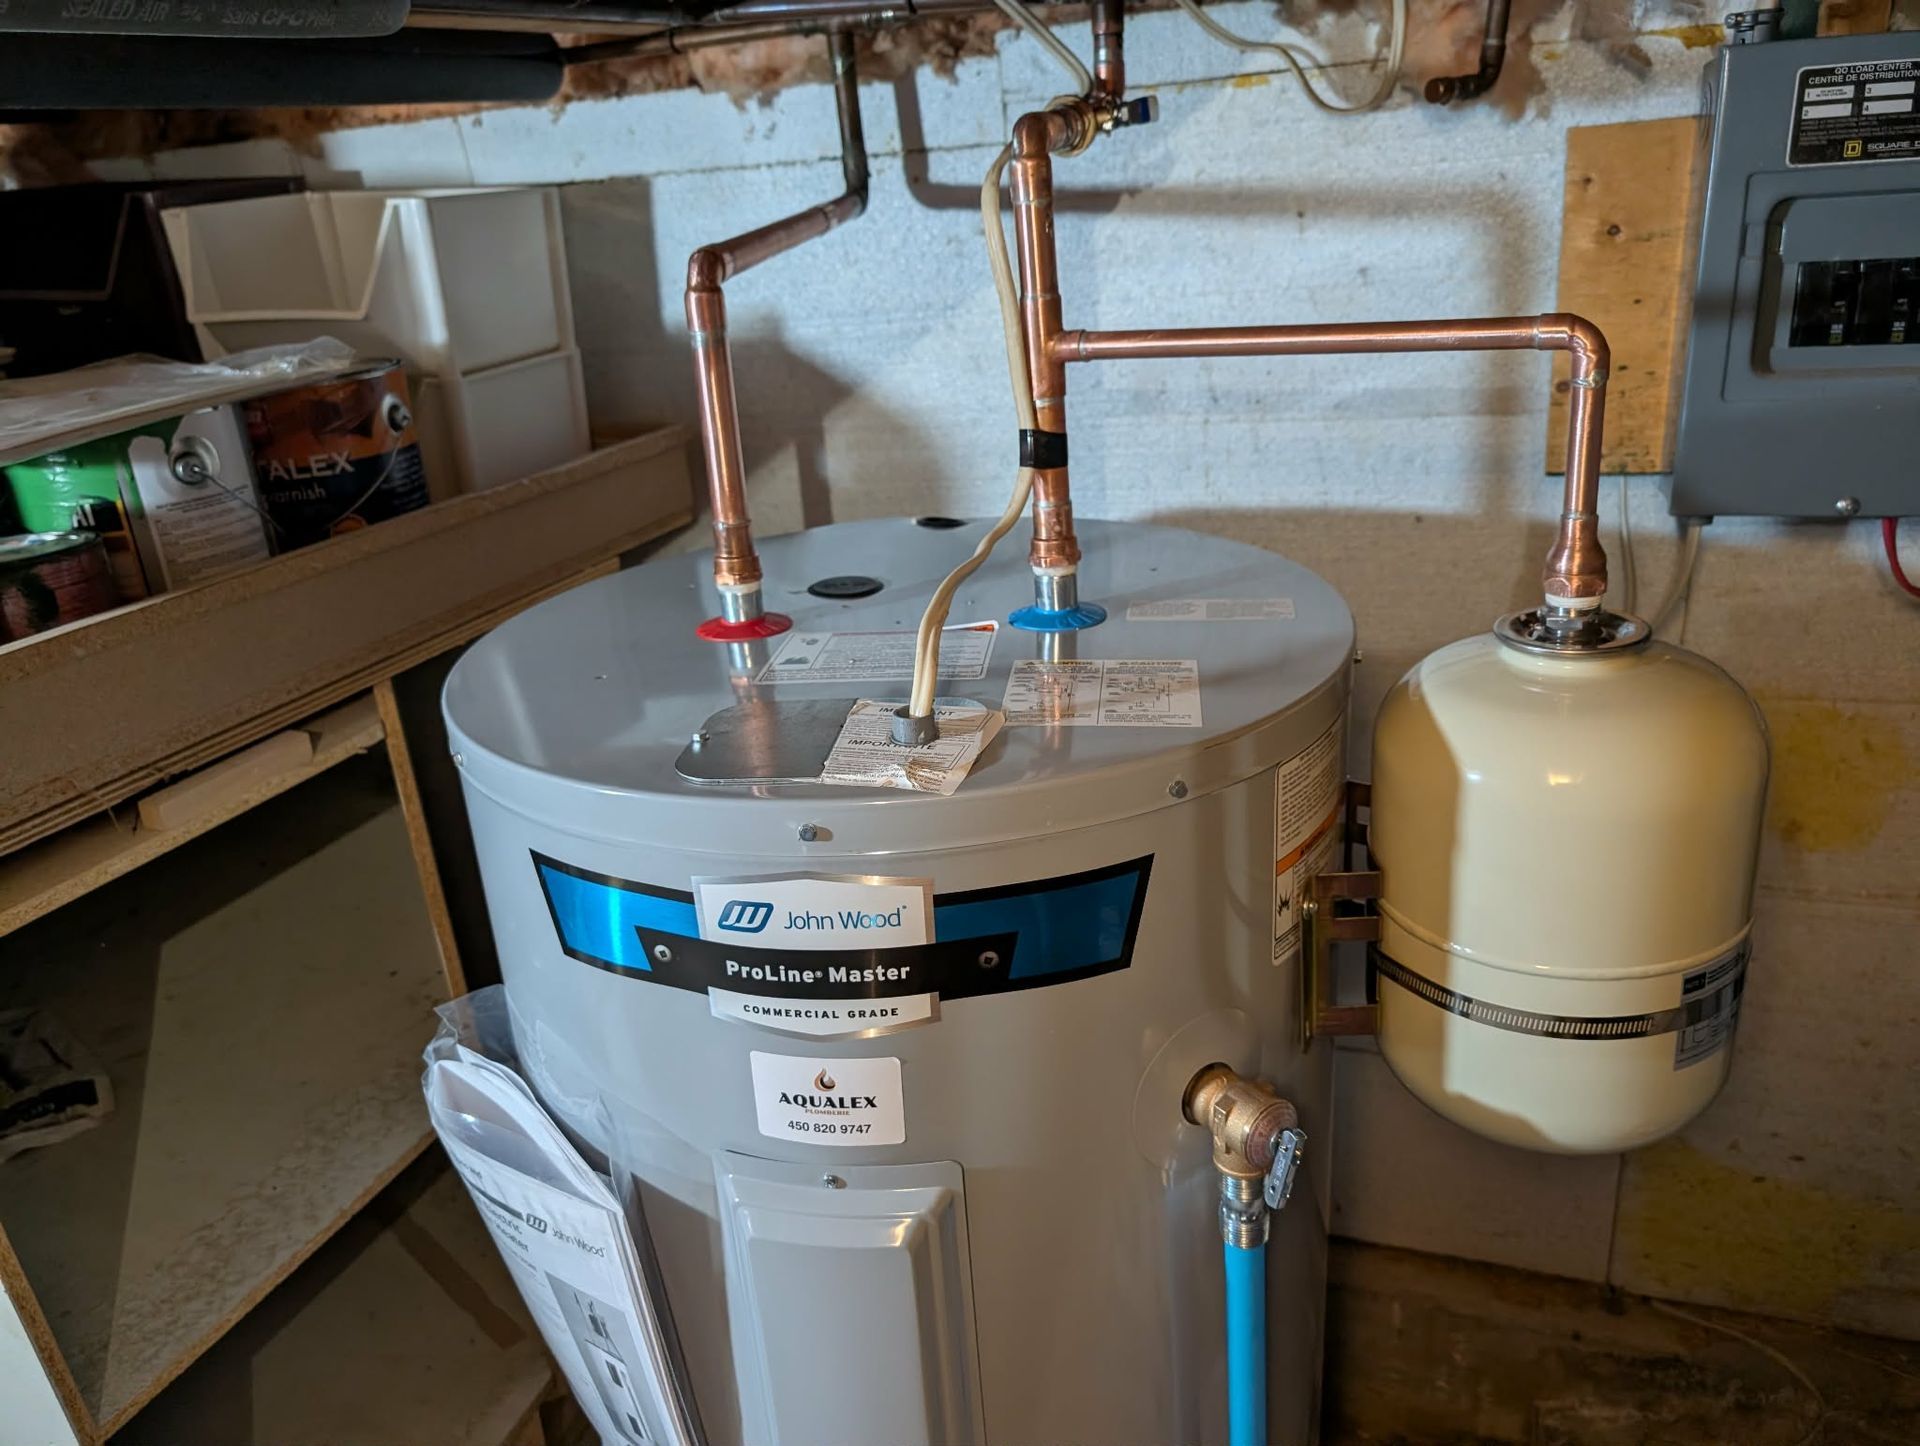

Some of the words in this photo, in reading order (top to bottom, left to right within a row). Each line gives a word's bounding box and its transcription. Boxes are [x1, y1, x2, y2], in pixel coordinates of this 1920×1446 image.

[1851, 64, 1875, 74] LOAD
[1876, 62, 1912, 72] CENTER
[1808, 74, 1844, 85] CENTRE
[1846, 74, 1858, 82] DE
[1860, 69, 1920, 81] DISTRIBUTION
[1867, 141, 1910, 150] SQUARE
[784, 910, 835, 930] John
[828, 964, 911, 983] Master
[743, 1004, 840, 1019] COMMERCIAL
[847, 1007, 899, 1019] GRADE
[778, 1091, 878, 1109] AQUALEX
[804, 1108, 851, 1116] PLOMBERIE
[787, 1120, 809, 1132] 450
[813, 1122, 837, 1134] 820
[840, 1123, 872, 1135] 9747
